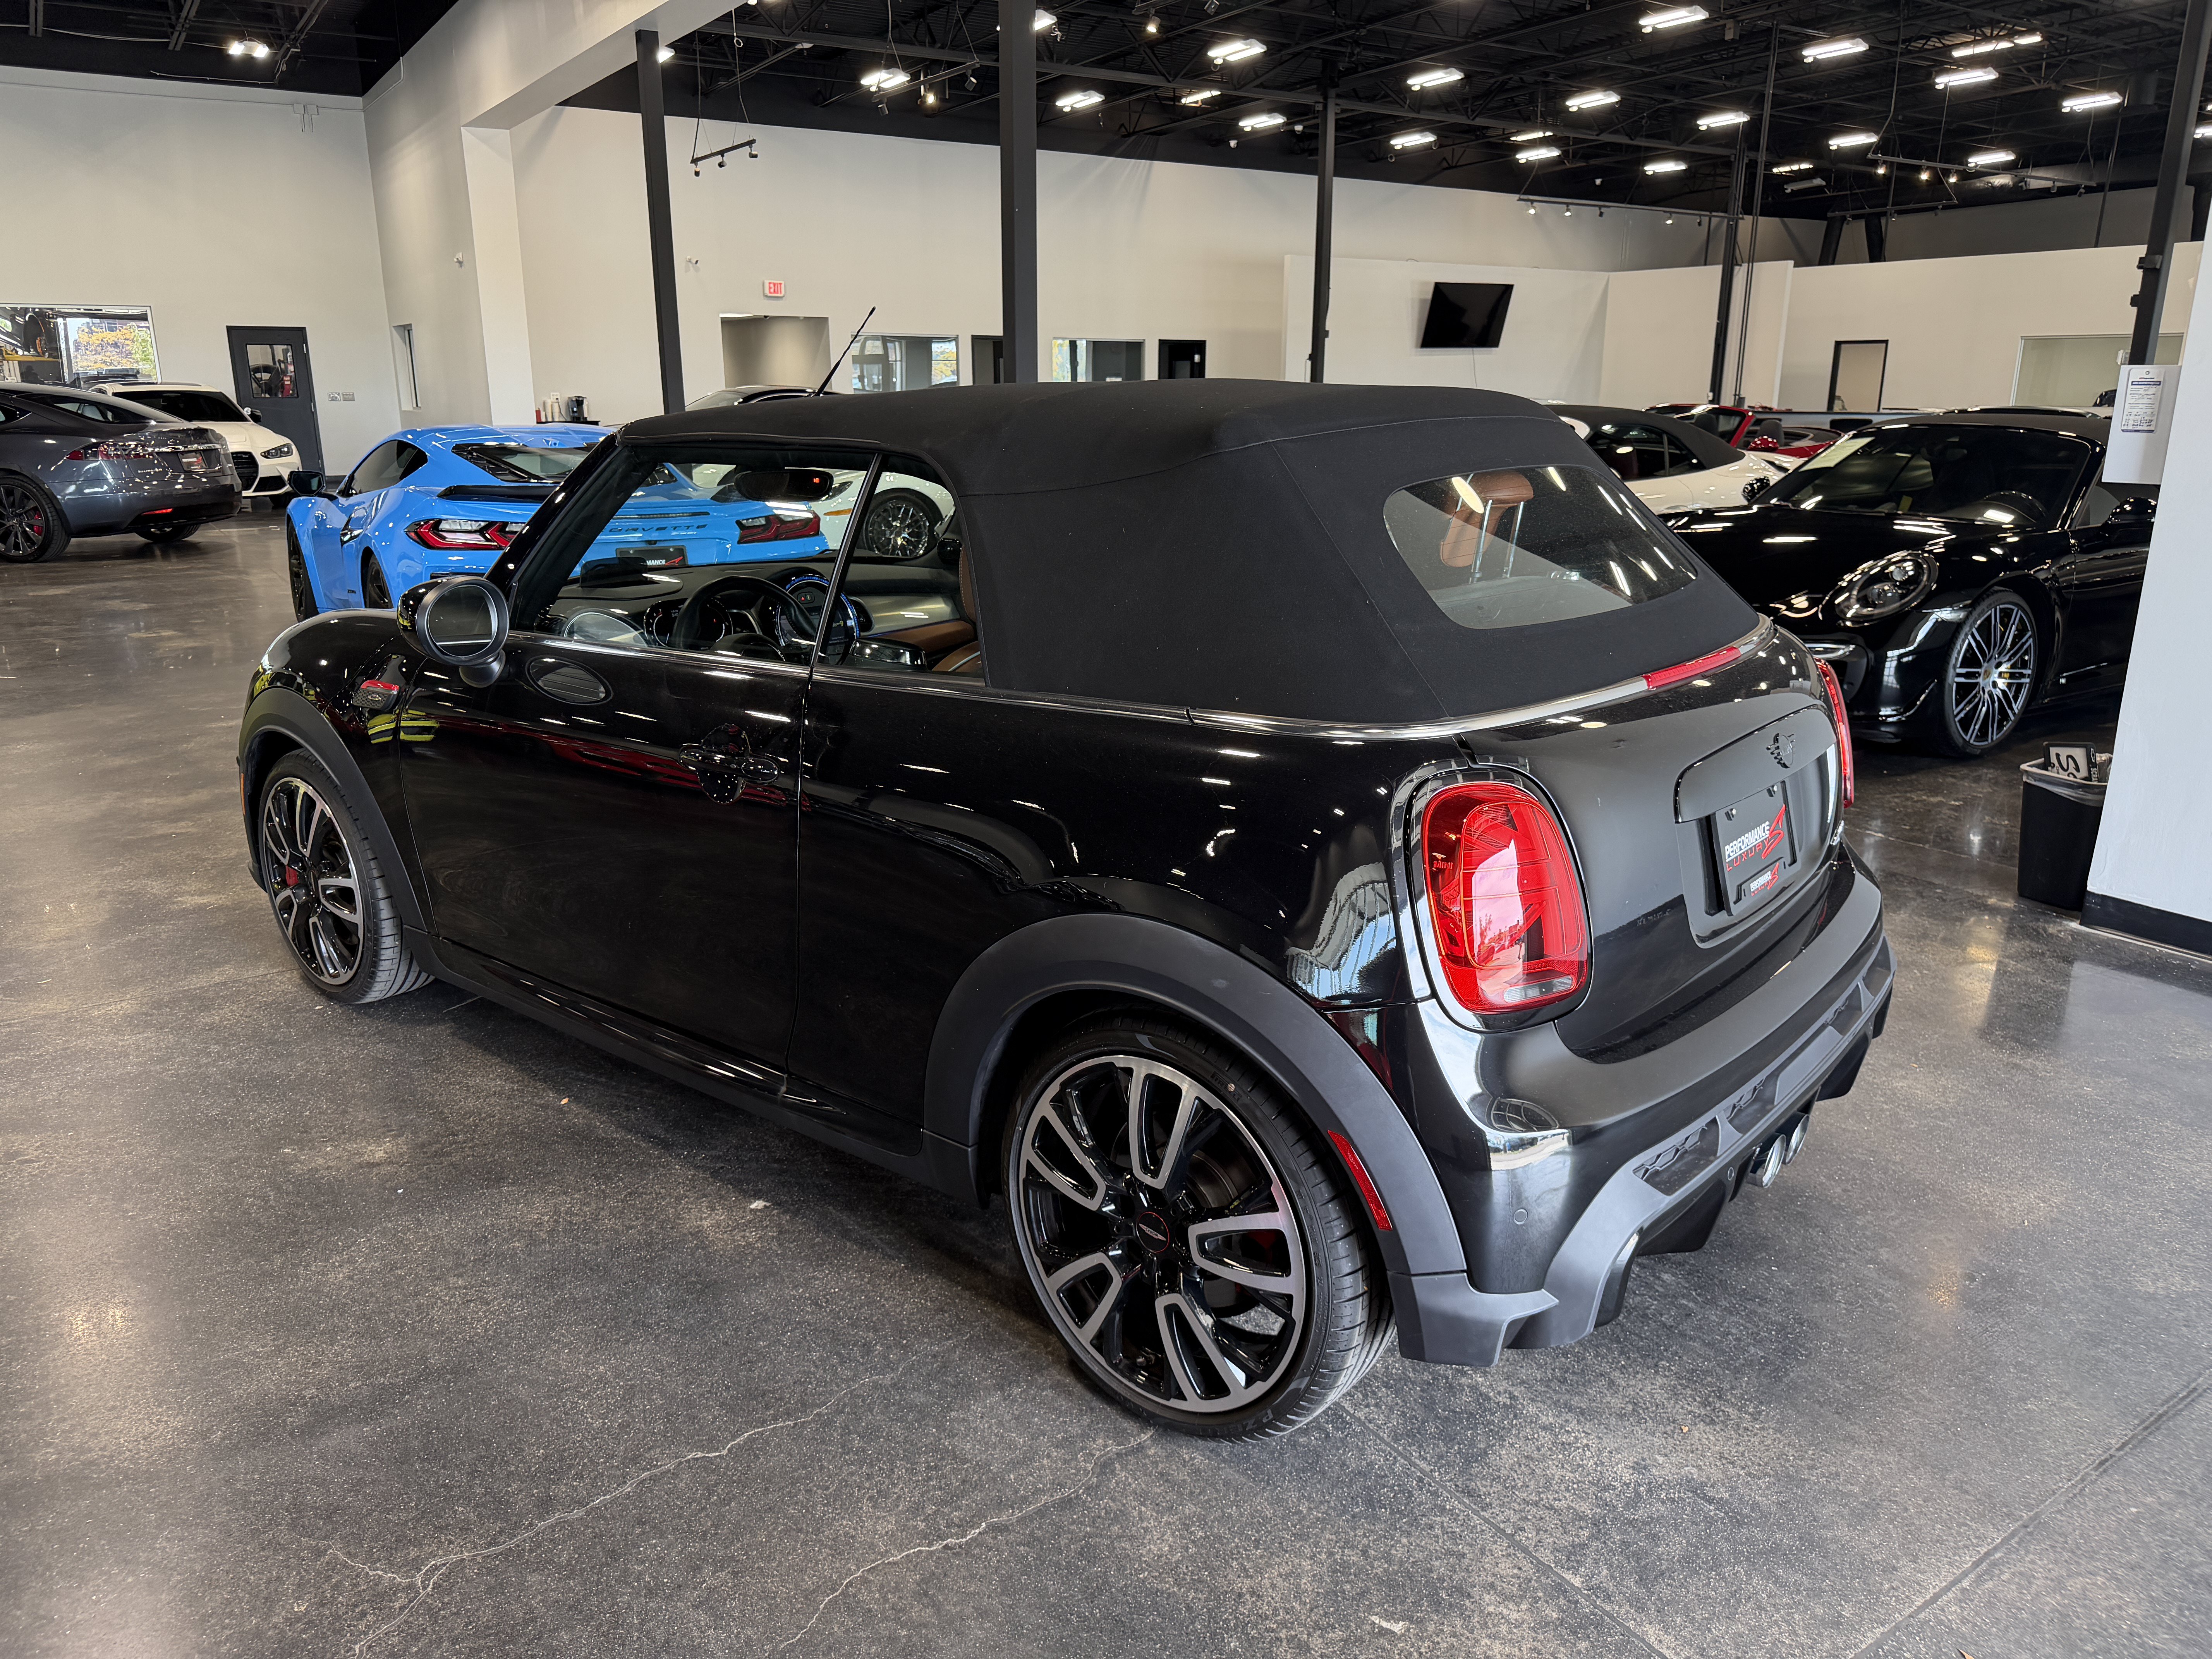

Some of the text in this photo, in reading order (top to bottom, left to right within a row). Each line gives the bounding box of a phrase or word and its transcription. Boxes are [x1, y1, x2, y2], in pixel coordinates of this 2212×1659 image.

[768, 282, 783, 294] EXIT
[602, 524, 708, 532] ORVETTE
[1725, 821, 1770, 860] PERFORMANCE
[1726, 837, 1771, 871] LUXURY
[1262, 1408, 1274, 1423] P
